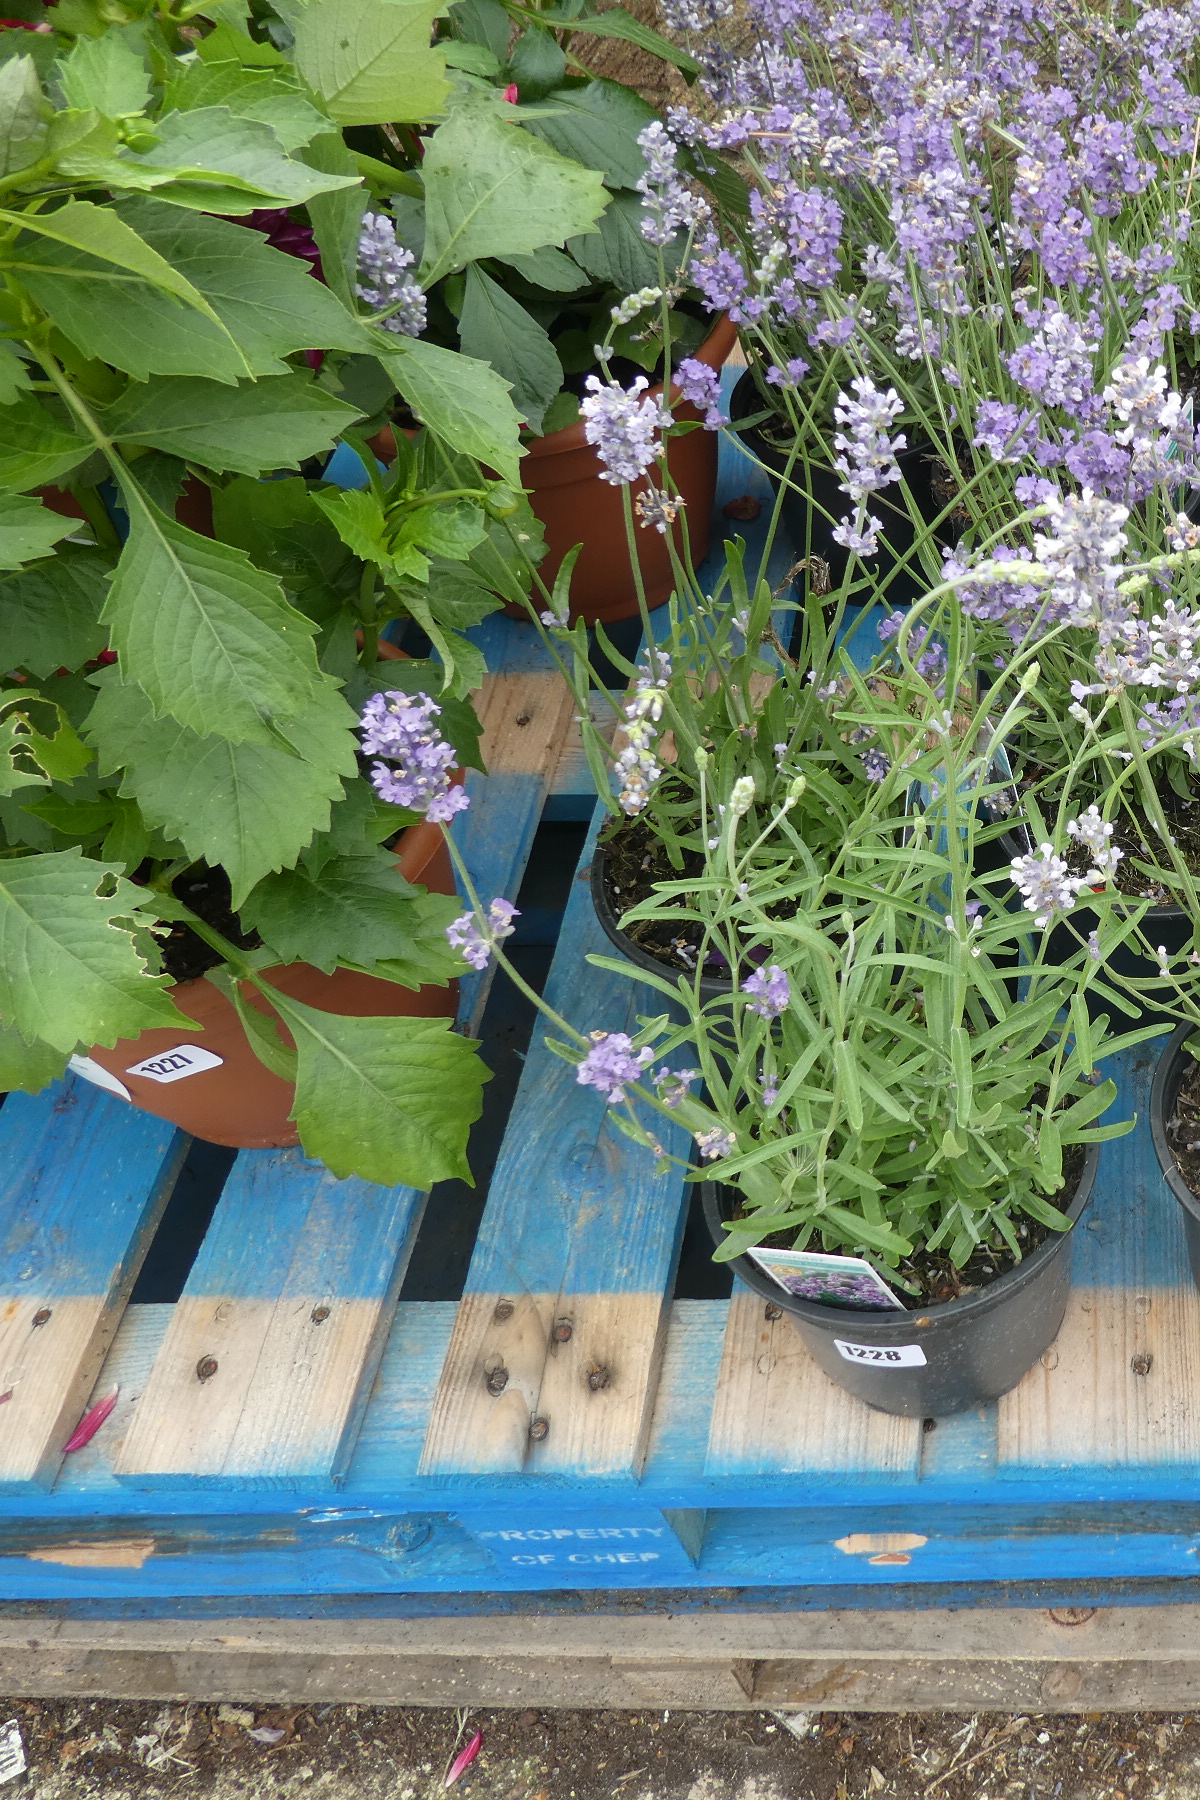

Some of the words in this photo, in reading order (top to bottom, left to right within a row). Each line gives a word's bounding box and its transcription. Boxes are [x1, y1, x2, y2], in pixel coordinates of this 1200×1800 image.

[141, 1054, 194, 1075] 1227
[841, 1345, 902, 1361] 1228
[477, 1527, 664, 1541] PROPERTY
[512, 1554, 555, 1565] OF
[568, 1552, 660, 1564] CHEP
